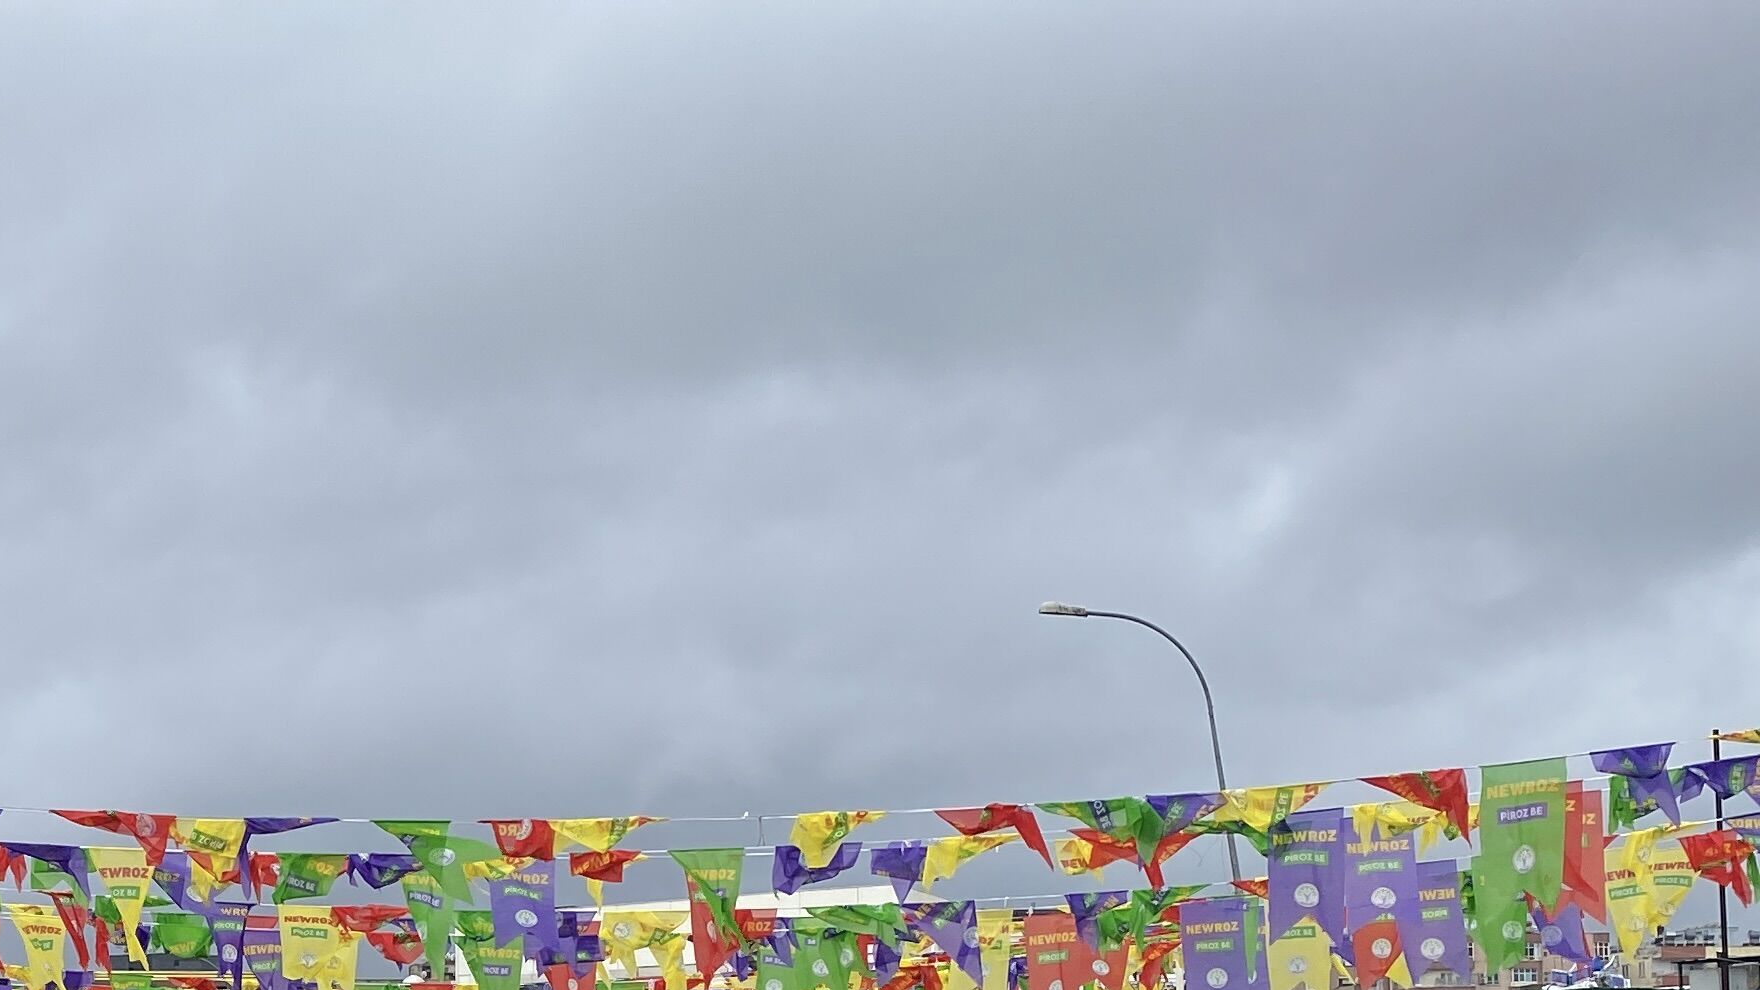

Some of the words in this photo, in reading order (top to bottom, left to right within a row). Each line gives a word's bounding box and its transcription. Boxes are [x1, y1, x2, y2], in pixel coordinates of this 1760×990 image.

[1487, 779, 1559, 800] NEWROZ
[1530, 806, 1544, 816] BE
[1272, 829, 1337, 846] NEWROZ
[99, 867, 149, 879] EWROZ
[1186, 921, 1239, 935] NEWROZ
[1029, 932, 1077, 945] NEWROZ
[243, 944, 282, 956] NEWRO
[479, 947, 521, 960] EWROZ
